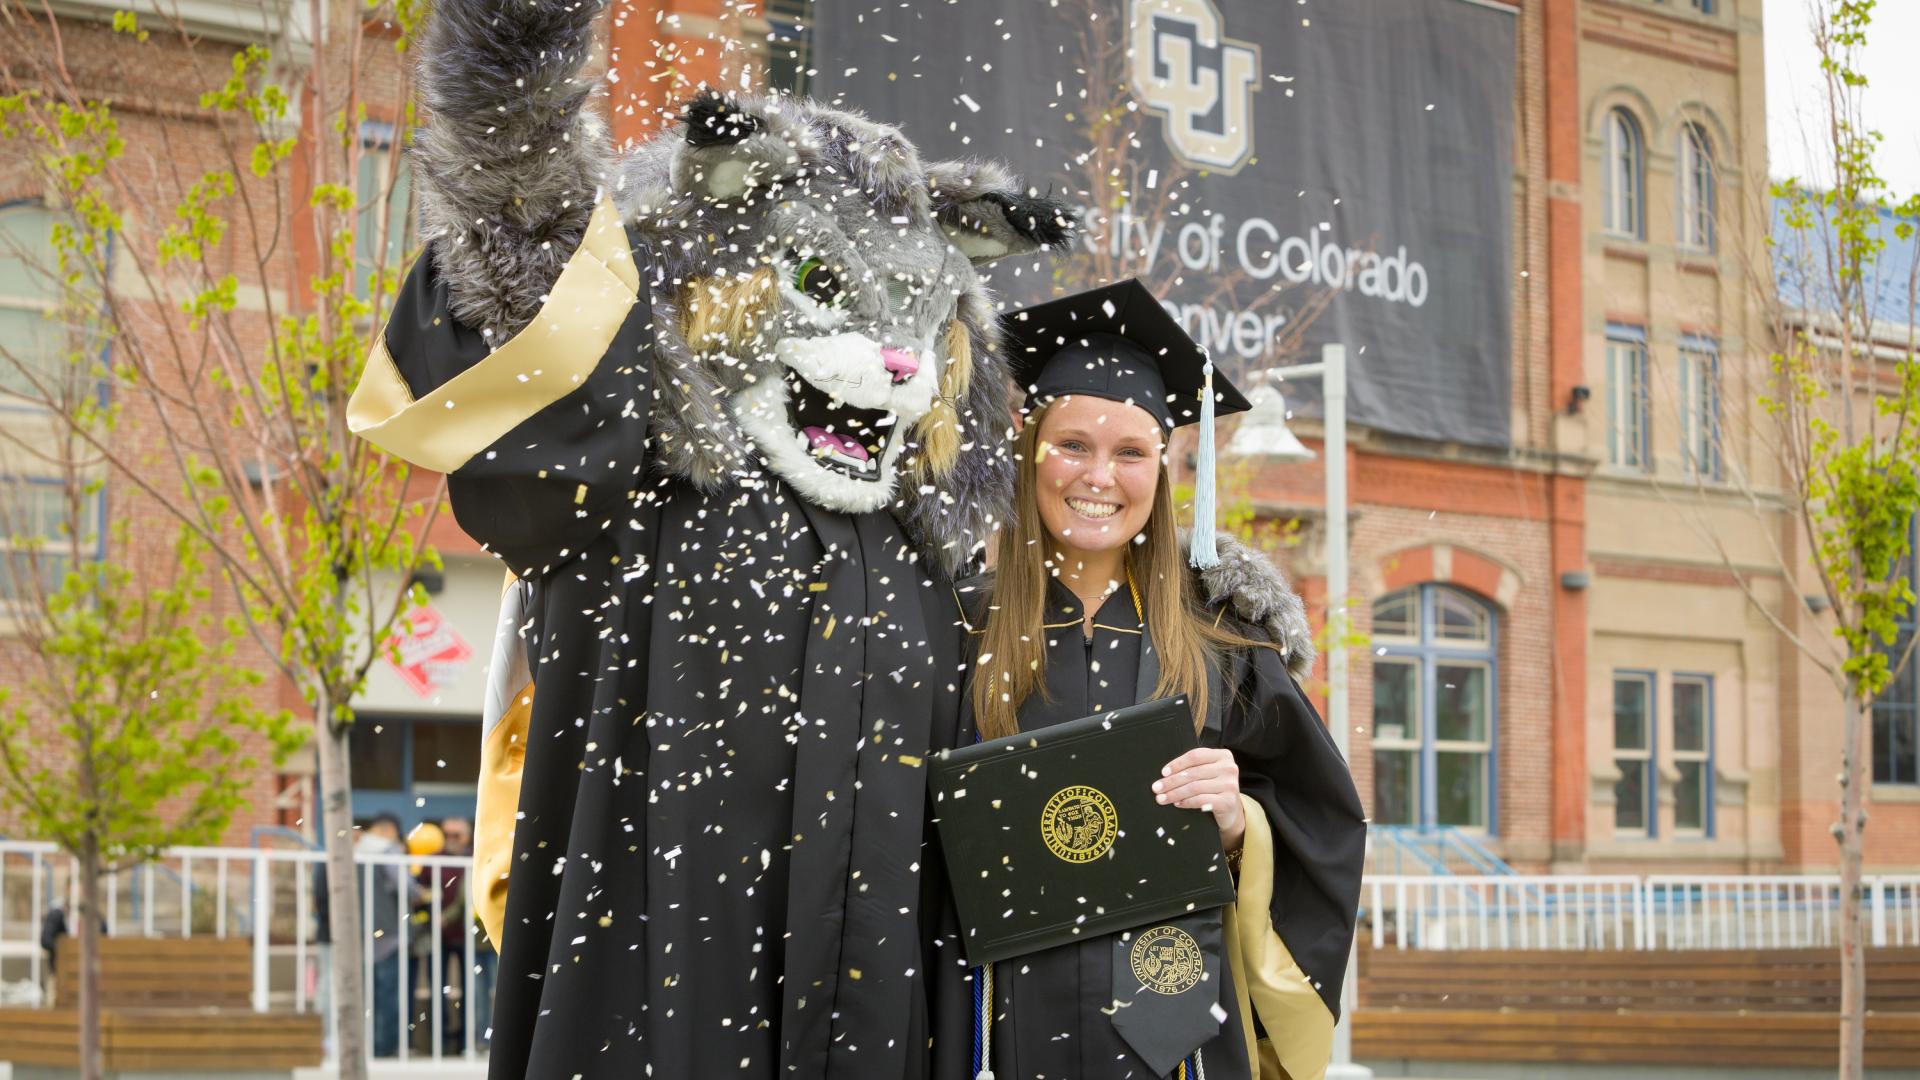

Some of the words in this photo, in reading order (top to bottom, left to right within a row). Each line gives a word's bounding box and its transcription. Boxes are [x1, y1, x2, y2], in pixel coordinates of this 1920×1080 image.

[1124, 0, 1262, 176] CU
[1178, 213, 1225, 272] of
[1237, 217, 1428, 307] Colorado
[1133, 929, 1159, 981] UNIVERSITY
[1163, 927, 1177, 936] OF
[1178, 933, 1201, 985] COLORADO
